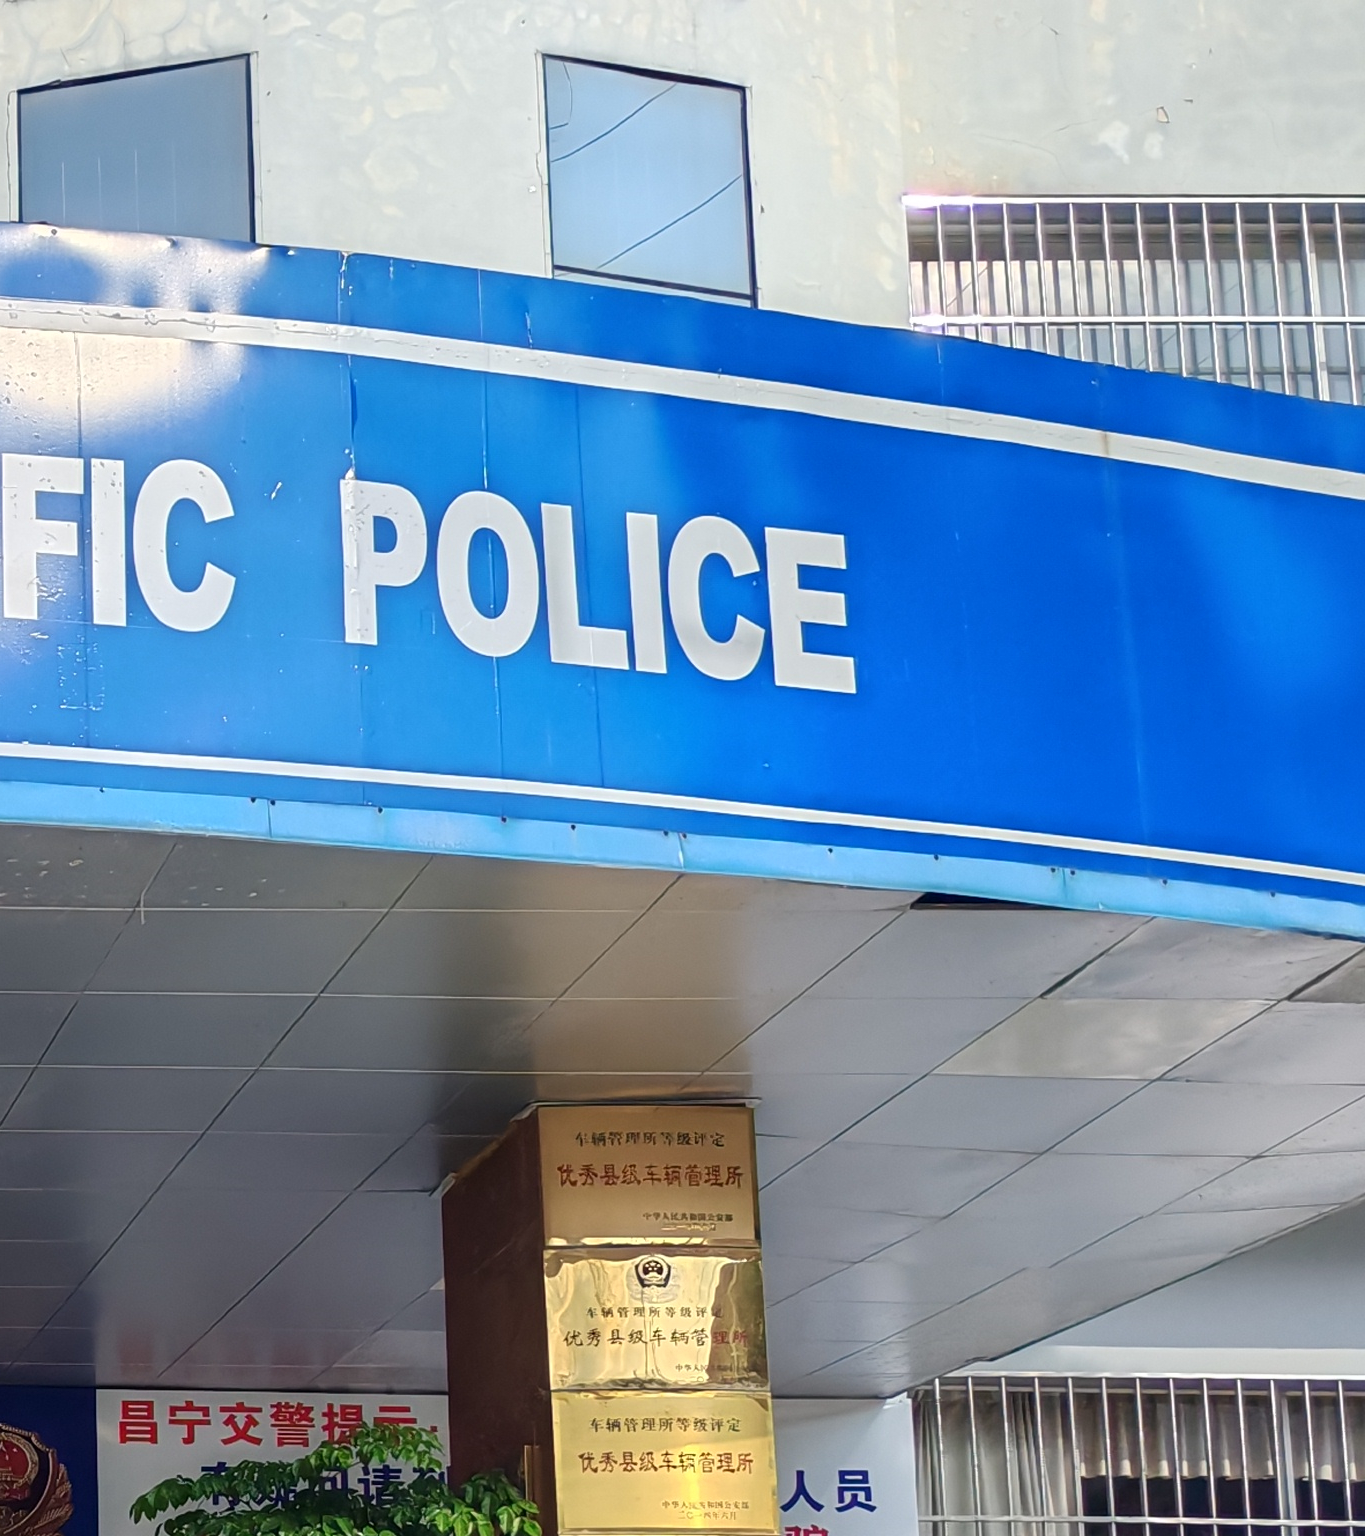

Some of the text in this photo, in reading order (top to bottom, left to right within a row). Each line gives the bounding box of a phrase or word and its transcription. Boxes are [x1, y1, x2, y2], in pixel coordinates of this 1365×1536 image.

[339, 475, 858, 696] POLICE
[557, 1164, 744, 1188] 优秀县级车辆管理所
[563, 1328, 749, 1347] 优秀县级车辆管理所
[590, 1417, 741, 1432] 车辆管理所等级评定
[578, 1451, 754, 1474] 优秀县级车辆管理所
[779, 1469, 878, 1513] 人员
